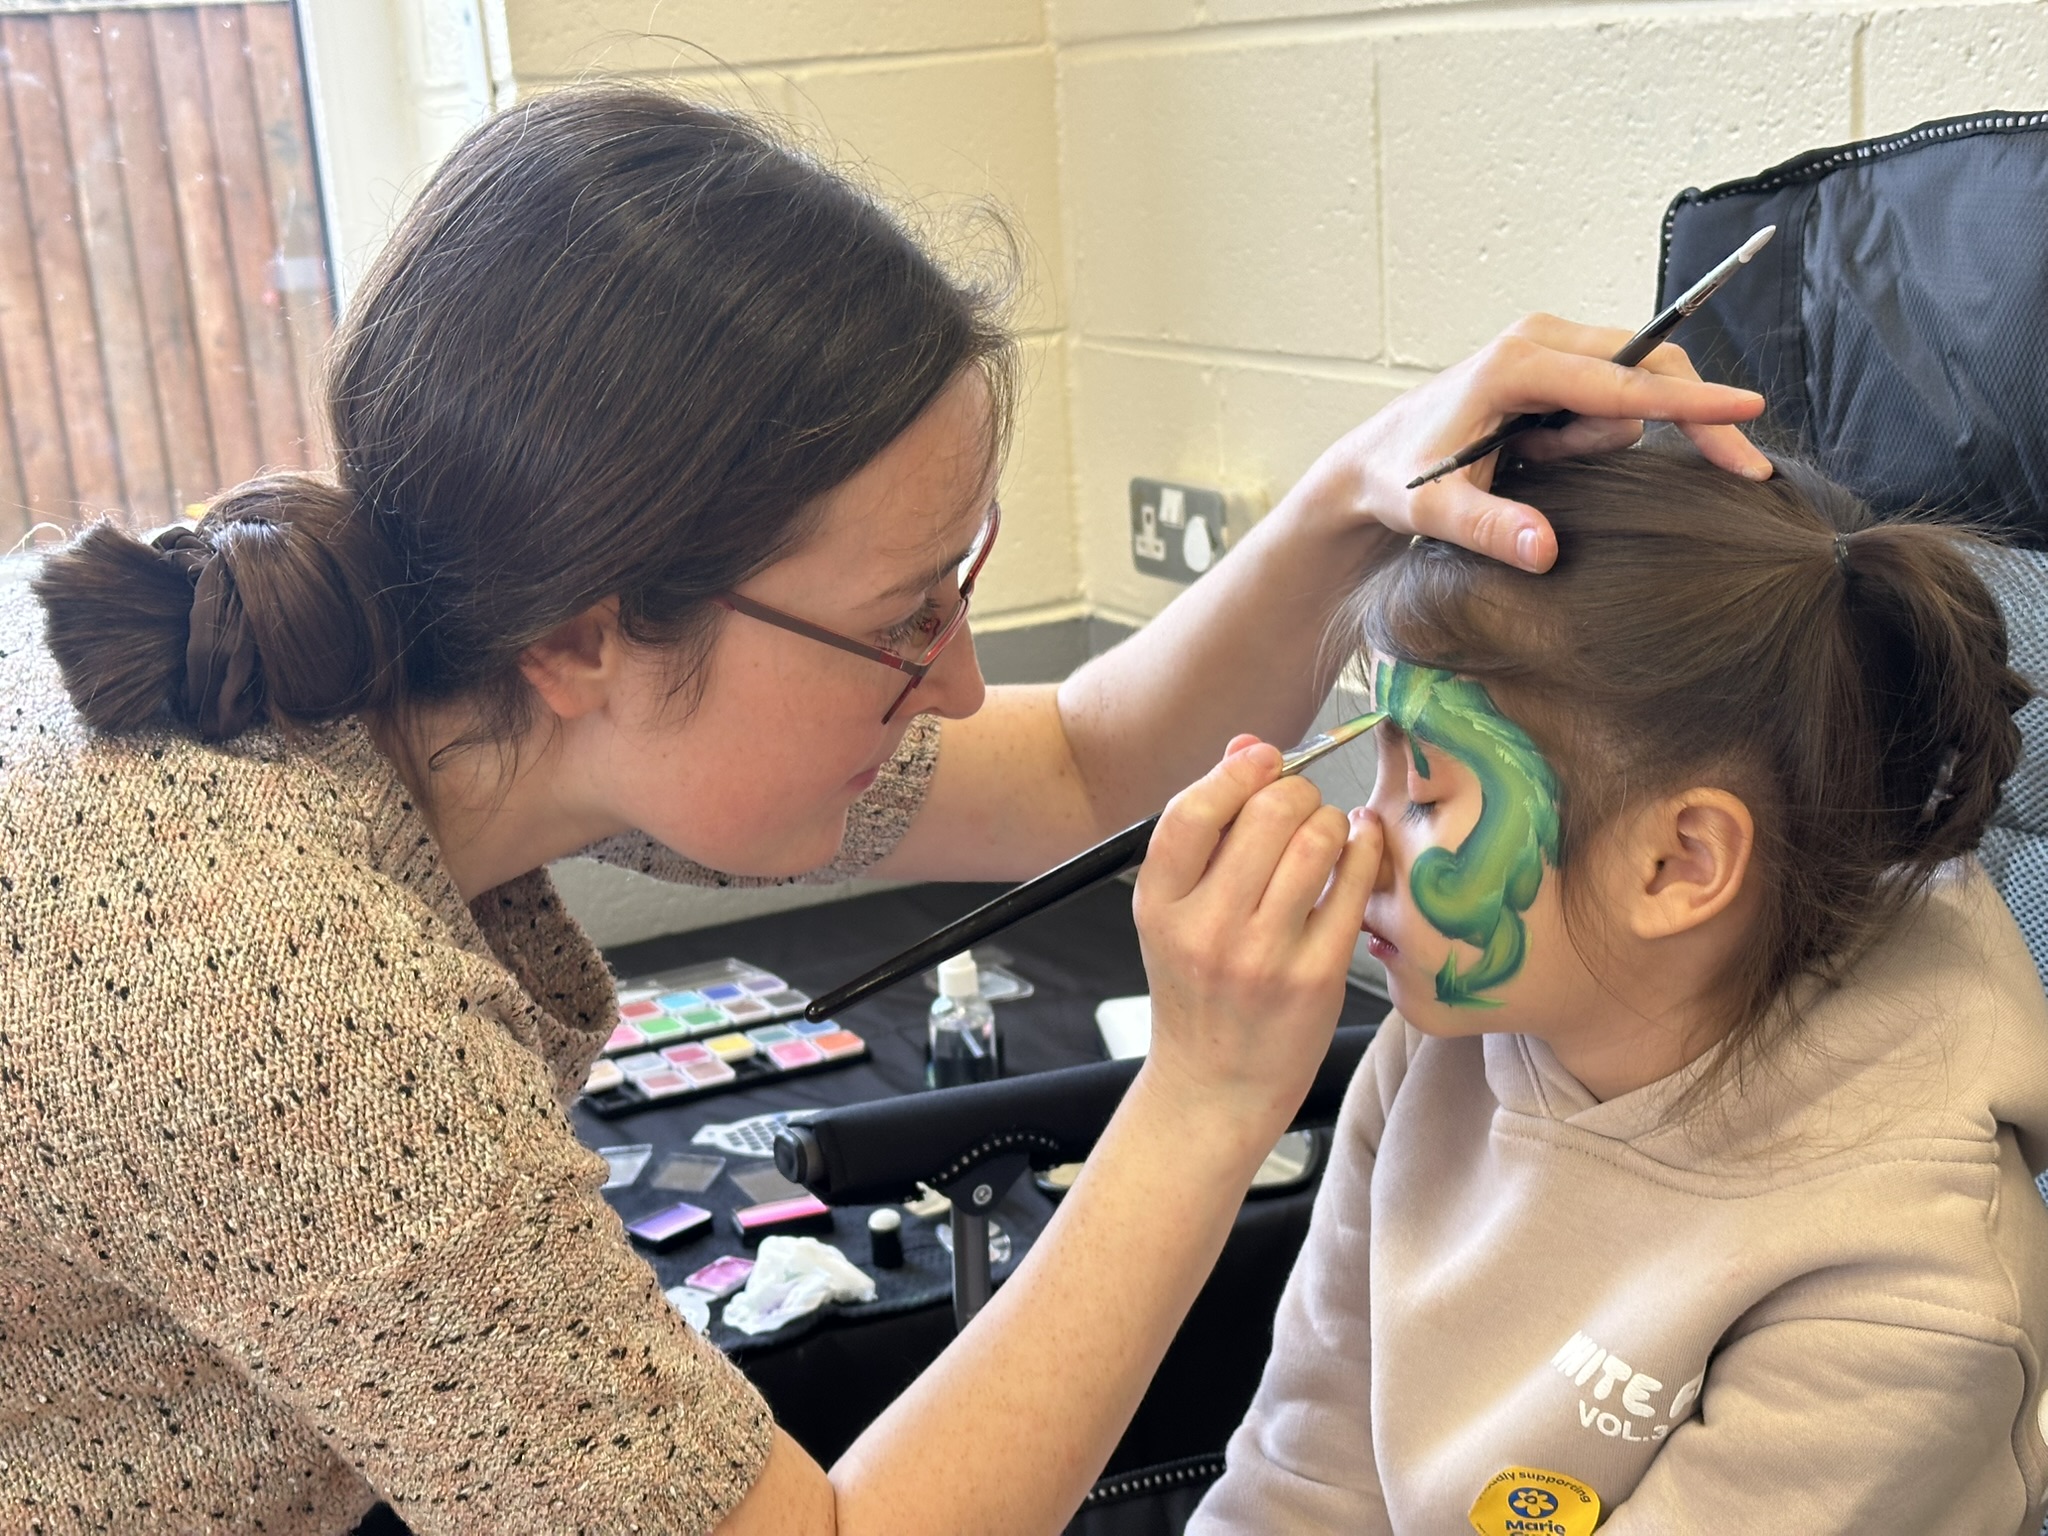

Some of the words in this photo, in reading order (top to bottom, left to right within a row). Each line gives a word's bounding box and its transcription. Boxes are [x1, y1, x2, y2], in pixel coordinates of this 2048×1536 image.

[1579, 1399, 1669, 1442] VOL.3
[1482, 1471, 1515, 1495] udly
[1518, 1471, 1591, 1503] supporting
[1505, 1520, 1566, 1535] Marie
